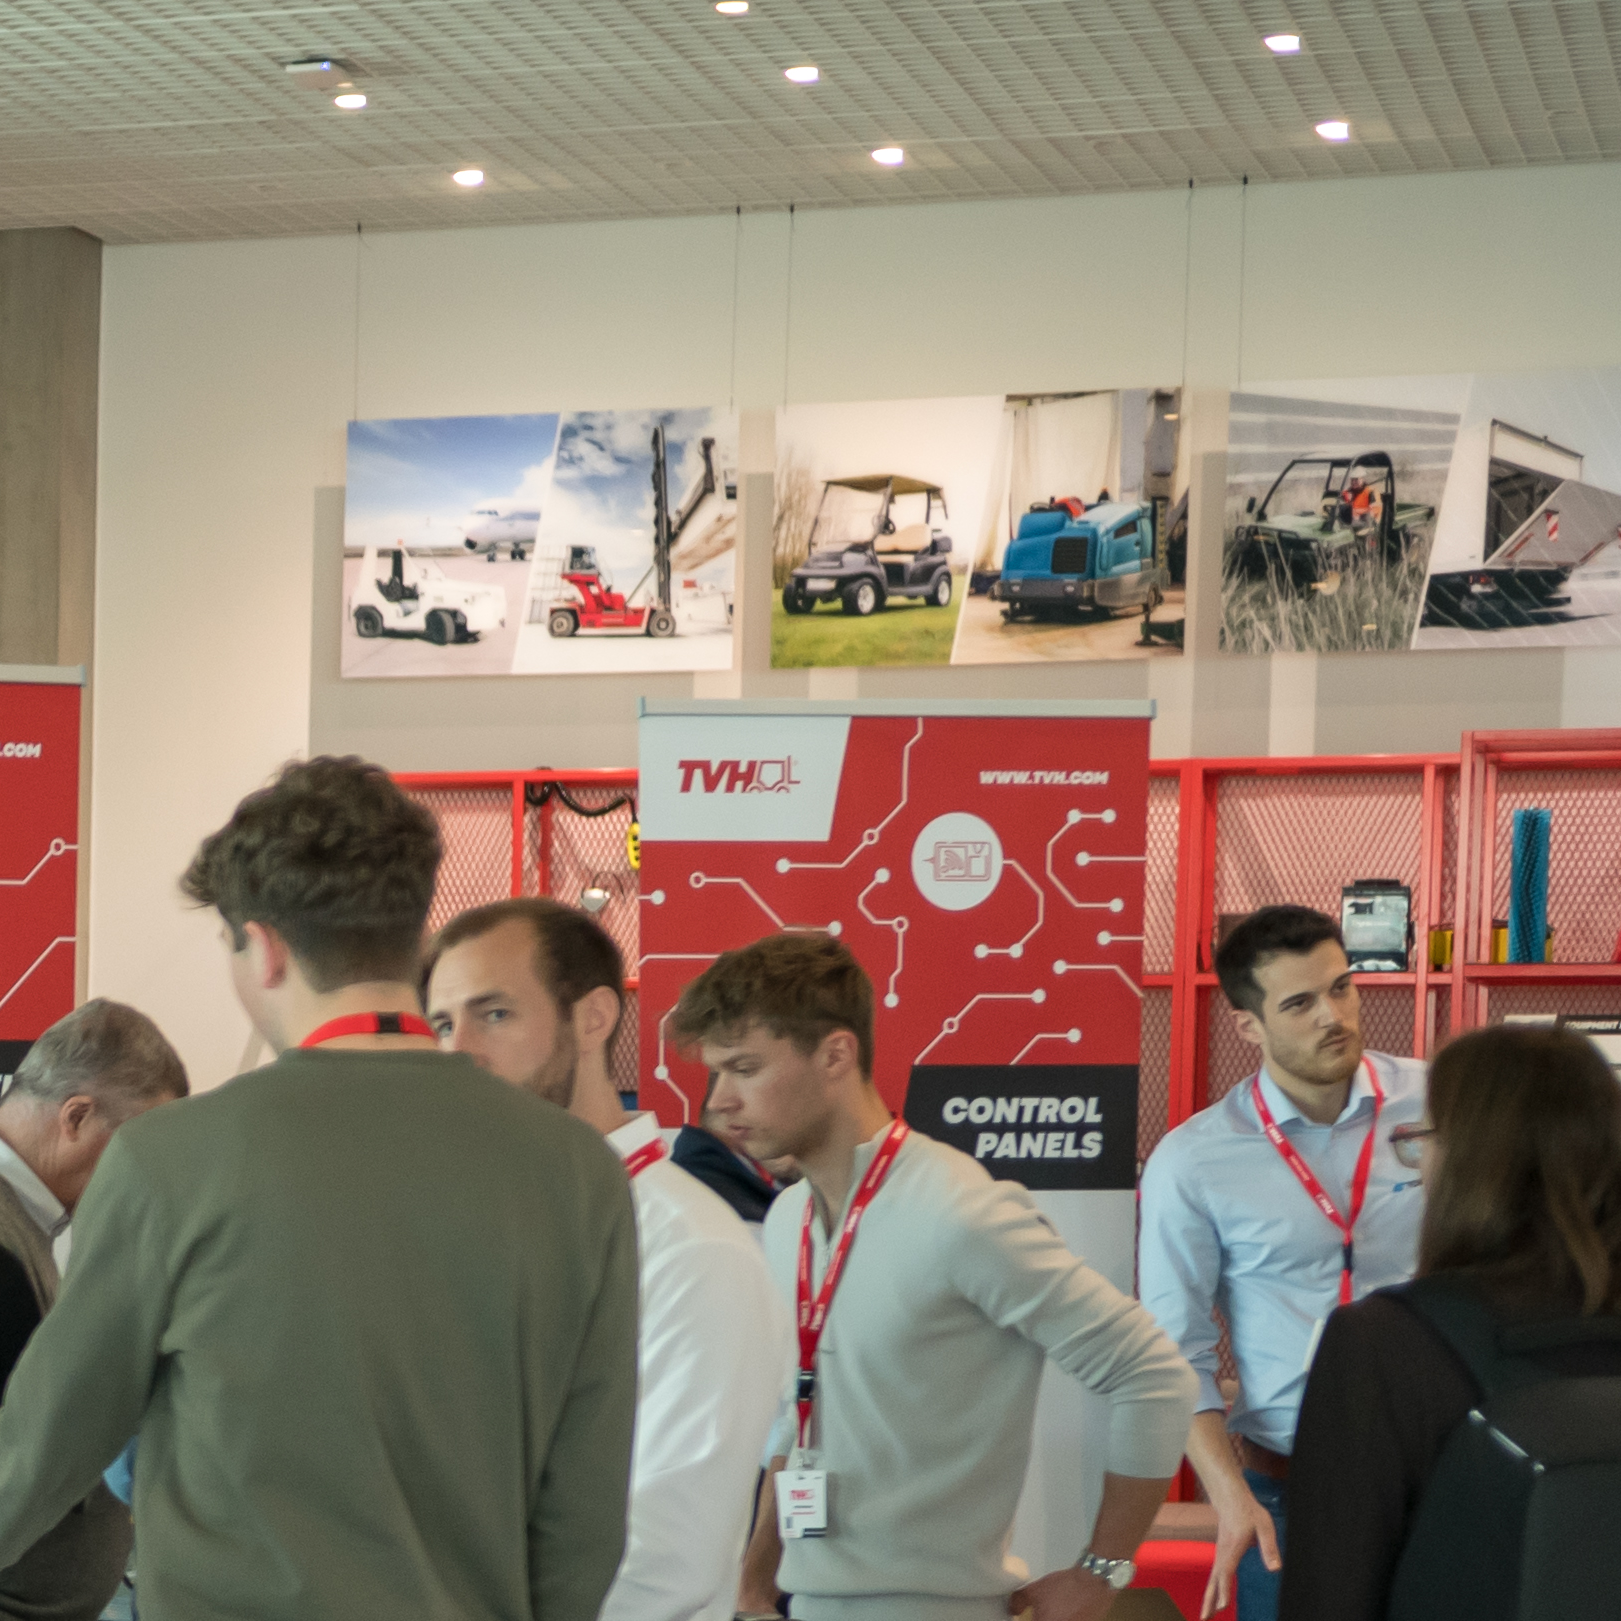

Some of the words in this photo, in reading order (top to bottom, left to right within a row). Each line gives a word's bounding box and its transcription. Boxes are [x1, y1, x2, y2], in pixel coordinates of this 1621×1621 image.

[678, 760, 757, 793] TVH
[979, 770, 1109, 785] WWW.TVH.COM
[942, 1096, 1103, 1124] CONTROL
[975, 1131, 1103, 1159] PANELS
